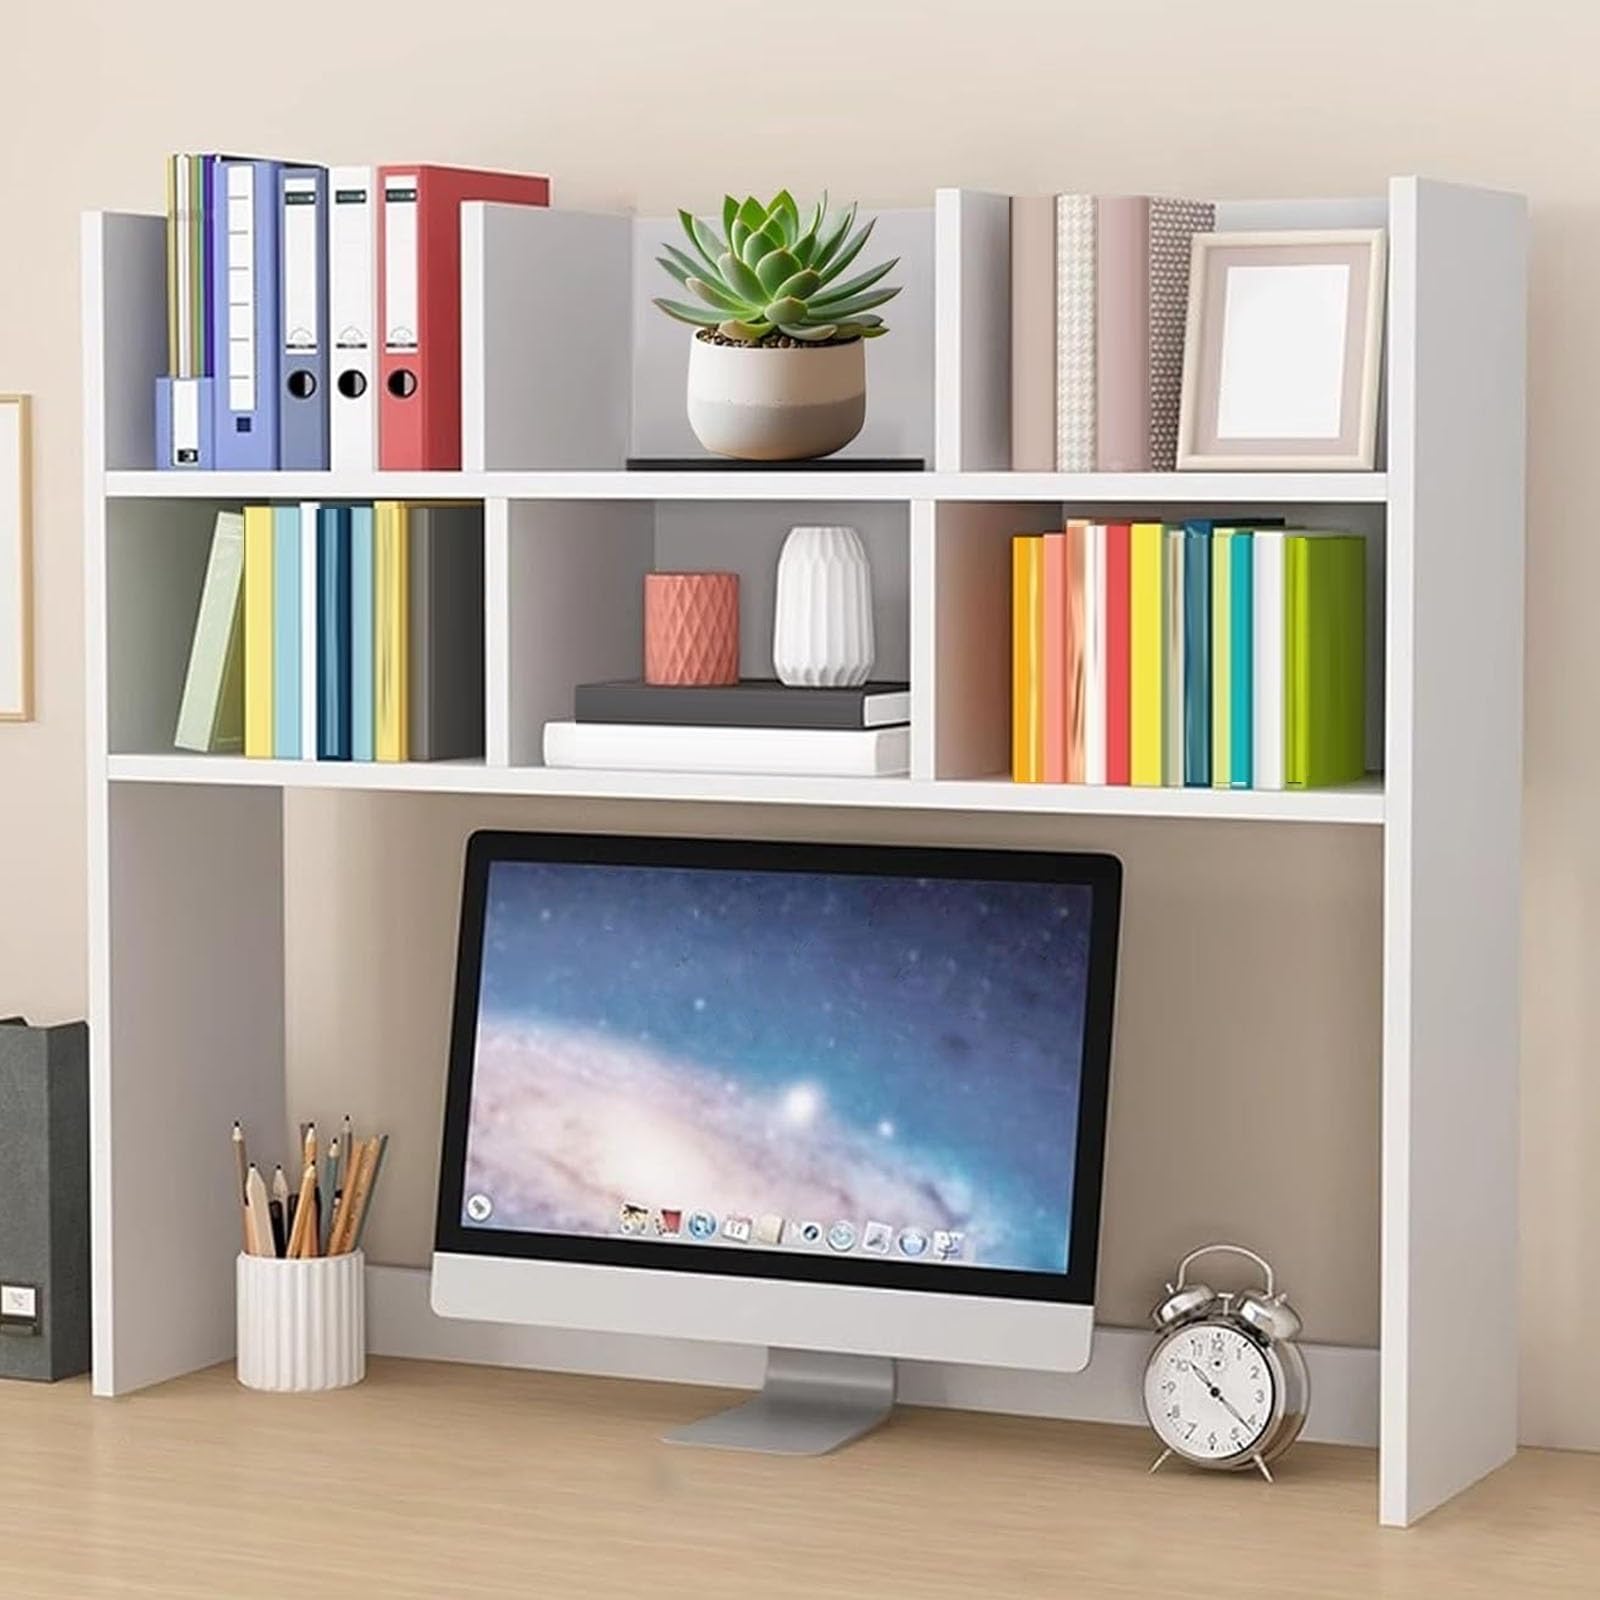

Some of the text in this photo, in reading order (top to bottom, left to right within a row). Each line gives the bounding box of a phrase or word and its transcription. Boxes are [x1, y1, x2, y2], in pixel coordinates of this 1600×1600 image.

[1250, 1366, 1260, 1379] 2
[1166, 1381, 1176, 1394] 9
[1255, 1390, 1265, 1403] 3
[1208, 1432, 1218, 1445] 6
